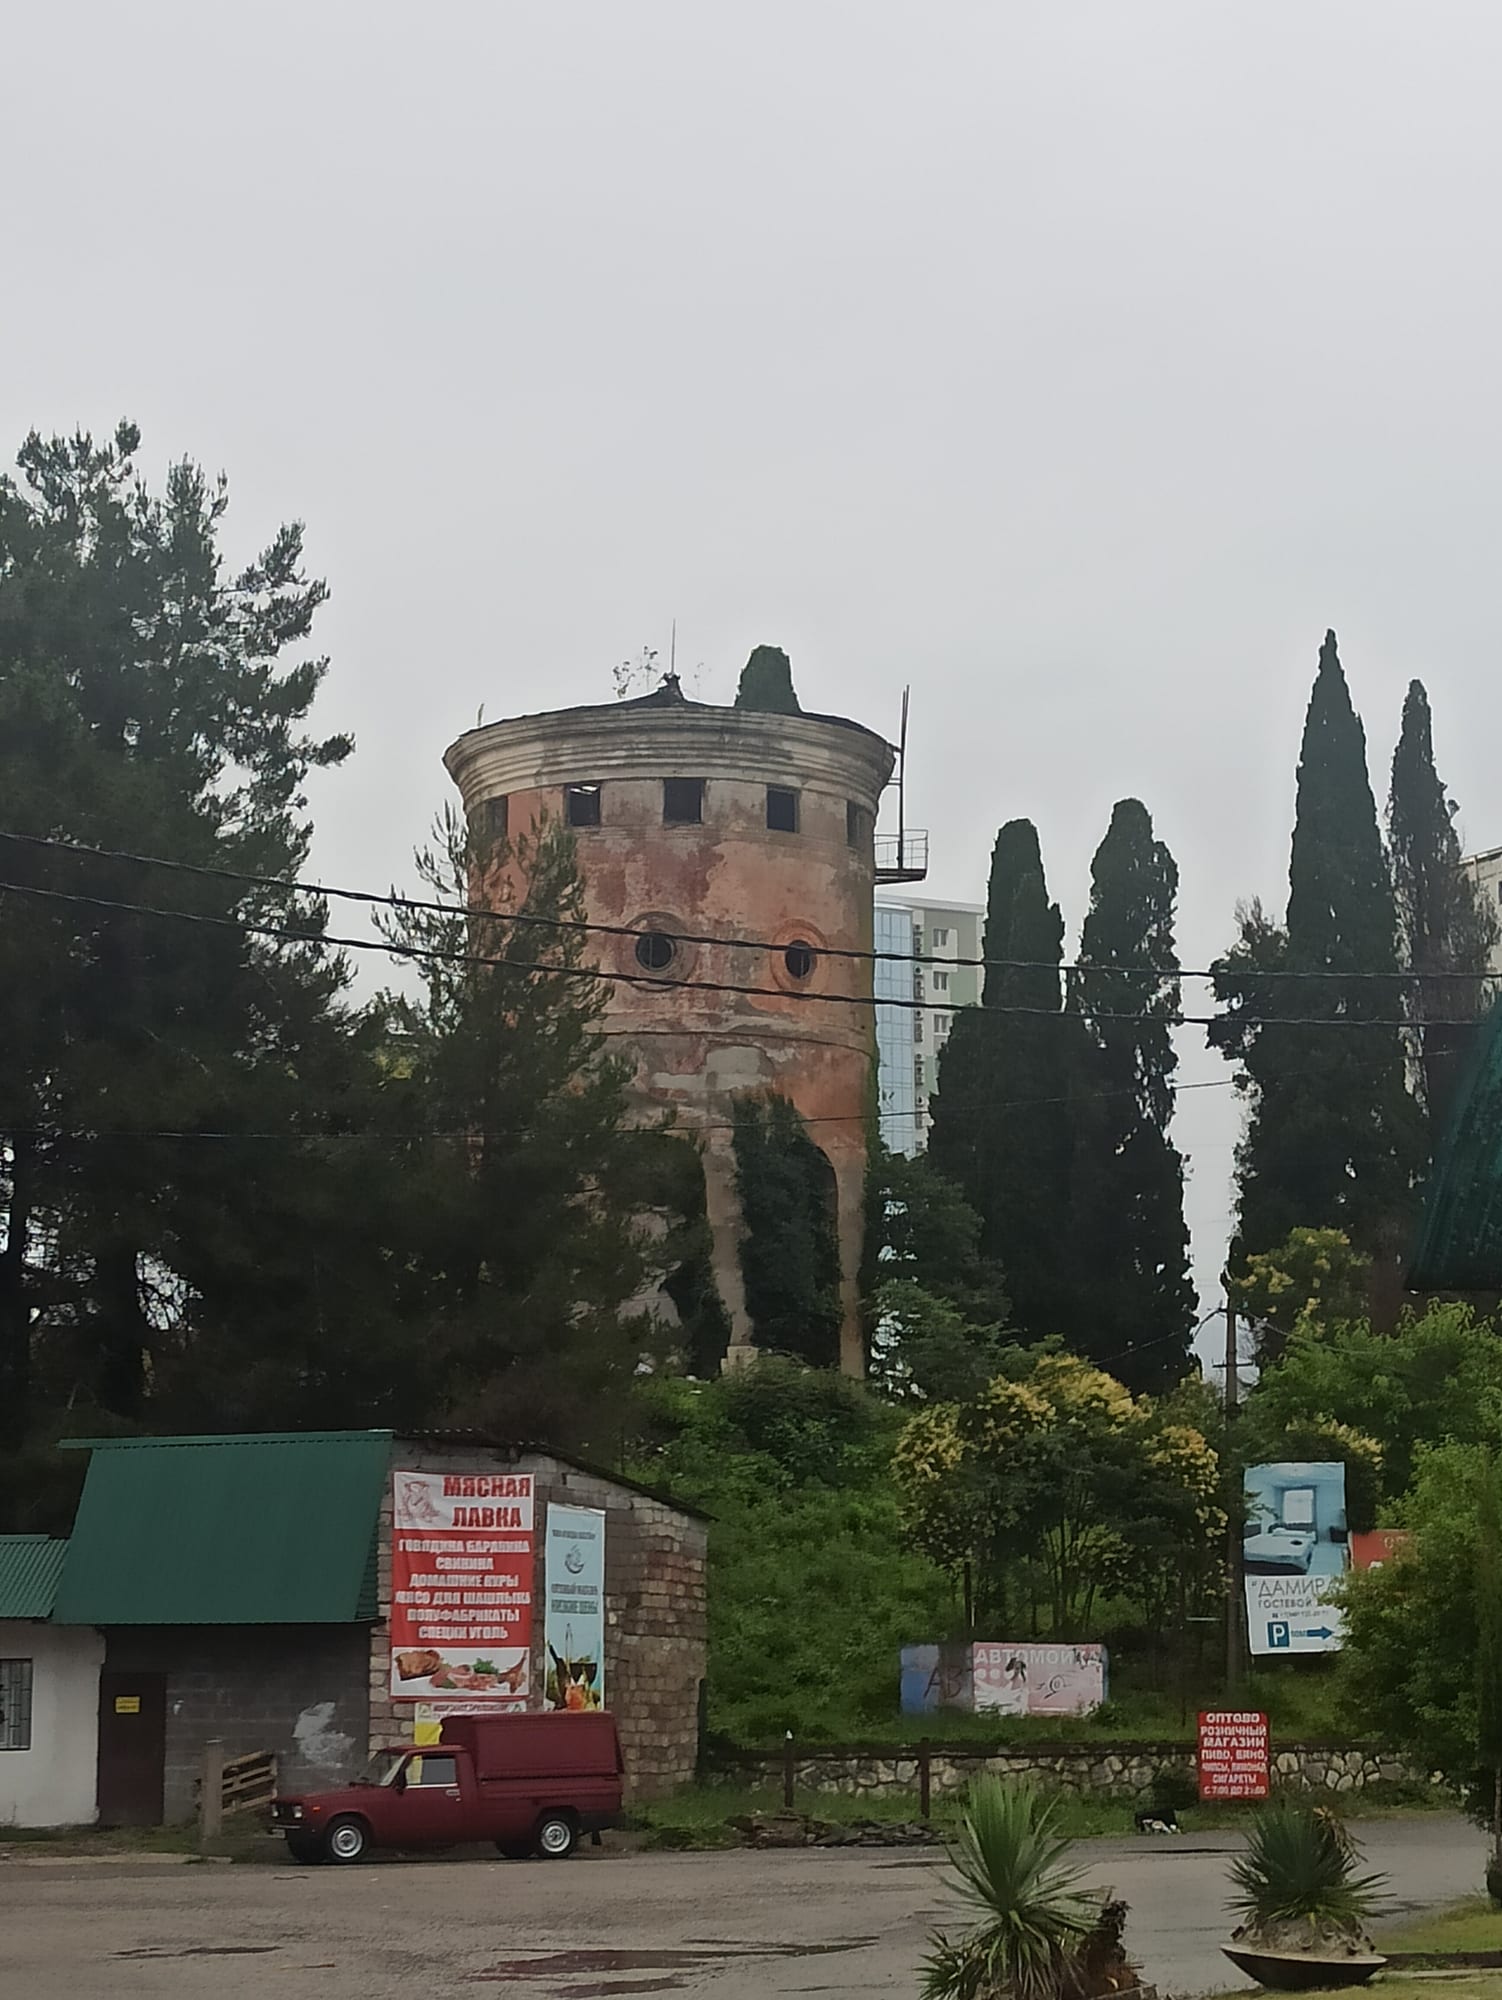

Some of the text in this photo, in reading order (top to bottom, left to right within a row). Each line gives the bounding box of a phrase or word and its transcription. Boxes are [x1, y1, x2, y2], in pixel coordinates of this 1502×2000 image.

[443, 1476, 530, 1498] МЯСНАЯ
[452, 1506, 522, 1528] ЛАВКА
[399, 1539, 530, 1554] ГОВЯДИНА БАРАНИНА
[436, 1557, 494, 1570] СВИНИНА
[409, 1573, 519, 1588] ДОМАШНИЕ КУРЫ
[395, 1591, 531, 1605] МЯСО ДЛЯ ШАШЛЫКА
[1258, 1596, 1312, 1609] ГОСТЕВОЙ
[407, 1608, 520, 1622] ПОЛУФАБРИКАТЫ
[468, 1626, 508, 1639] УГОЛЬ
[1272, 1624, 1286, 1646] P
[1206, 1712, 1260, 1723] ОПТОВО
[1200, 1724, 1267, 1736] РОЗНИЧНЫЙ
[1203, 1736, 1265, 1748] МАГАЗИН
[1201, 1749, 1268, 1762] ПИВО, ВИНО,
[1212, 1774, 1257, 1784] СИГАРЕТЫ
[1230, 1786, 1243, 1796] ДО
